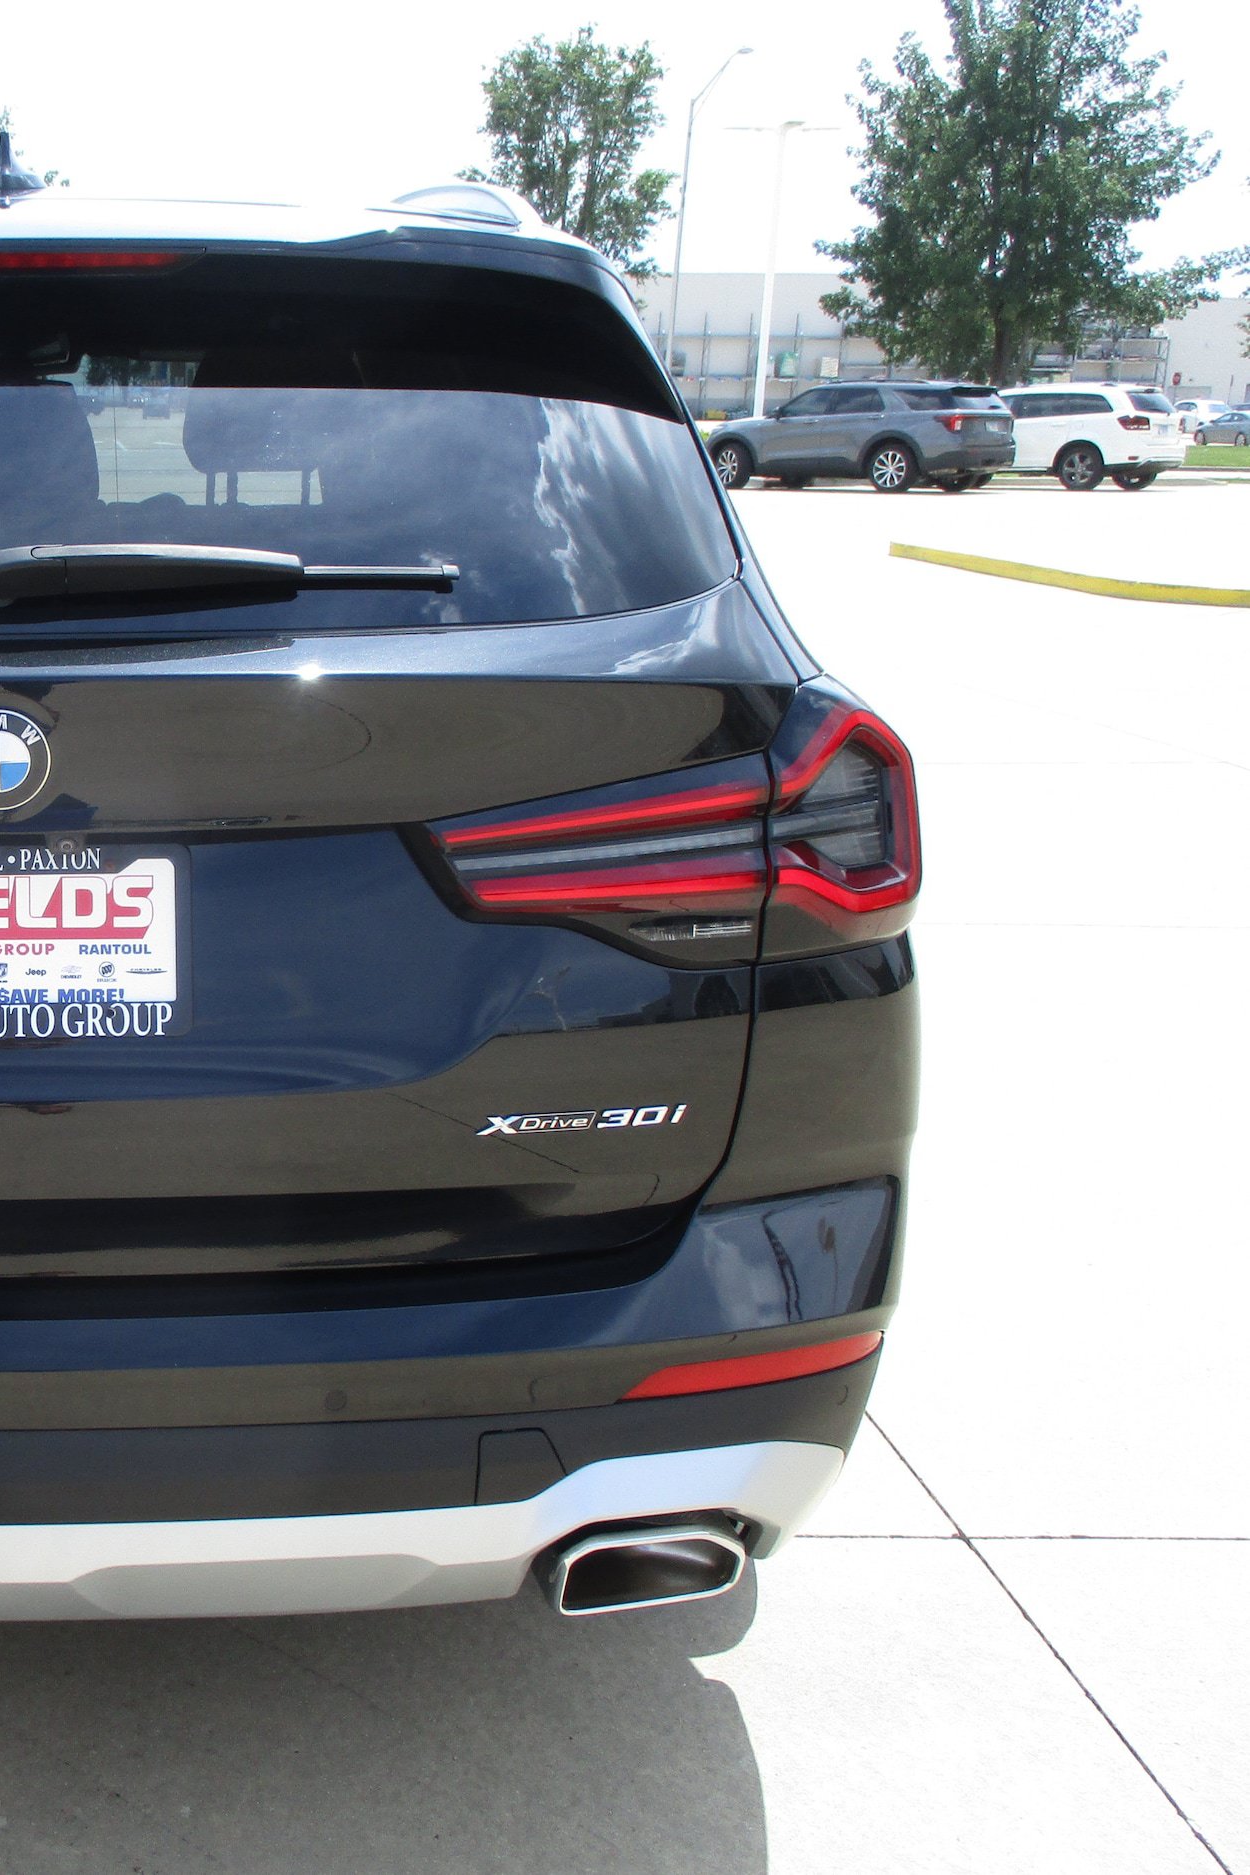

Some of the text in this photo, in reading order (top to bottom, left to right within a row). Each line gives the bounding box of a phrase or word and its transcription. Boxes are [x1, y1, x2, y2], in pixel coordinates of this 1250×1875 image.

[19, 848, 100, 870] PAXTON
[78, 943, 152, 955] RANTOUL
[25, 967, 47, 976] Jeep
[57, 988, 125, 1003] MORE!
[61, 1002, 173, 1038] GROUP
